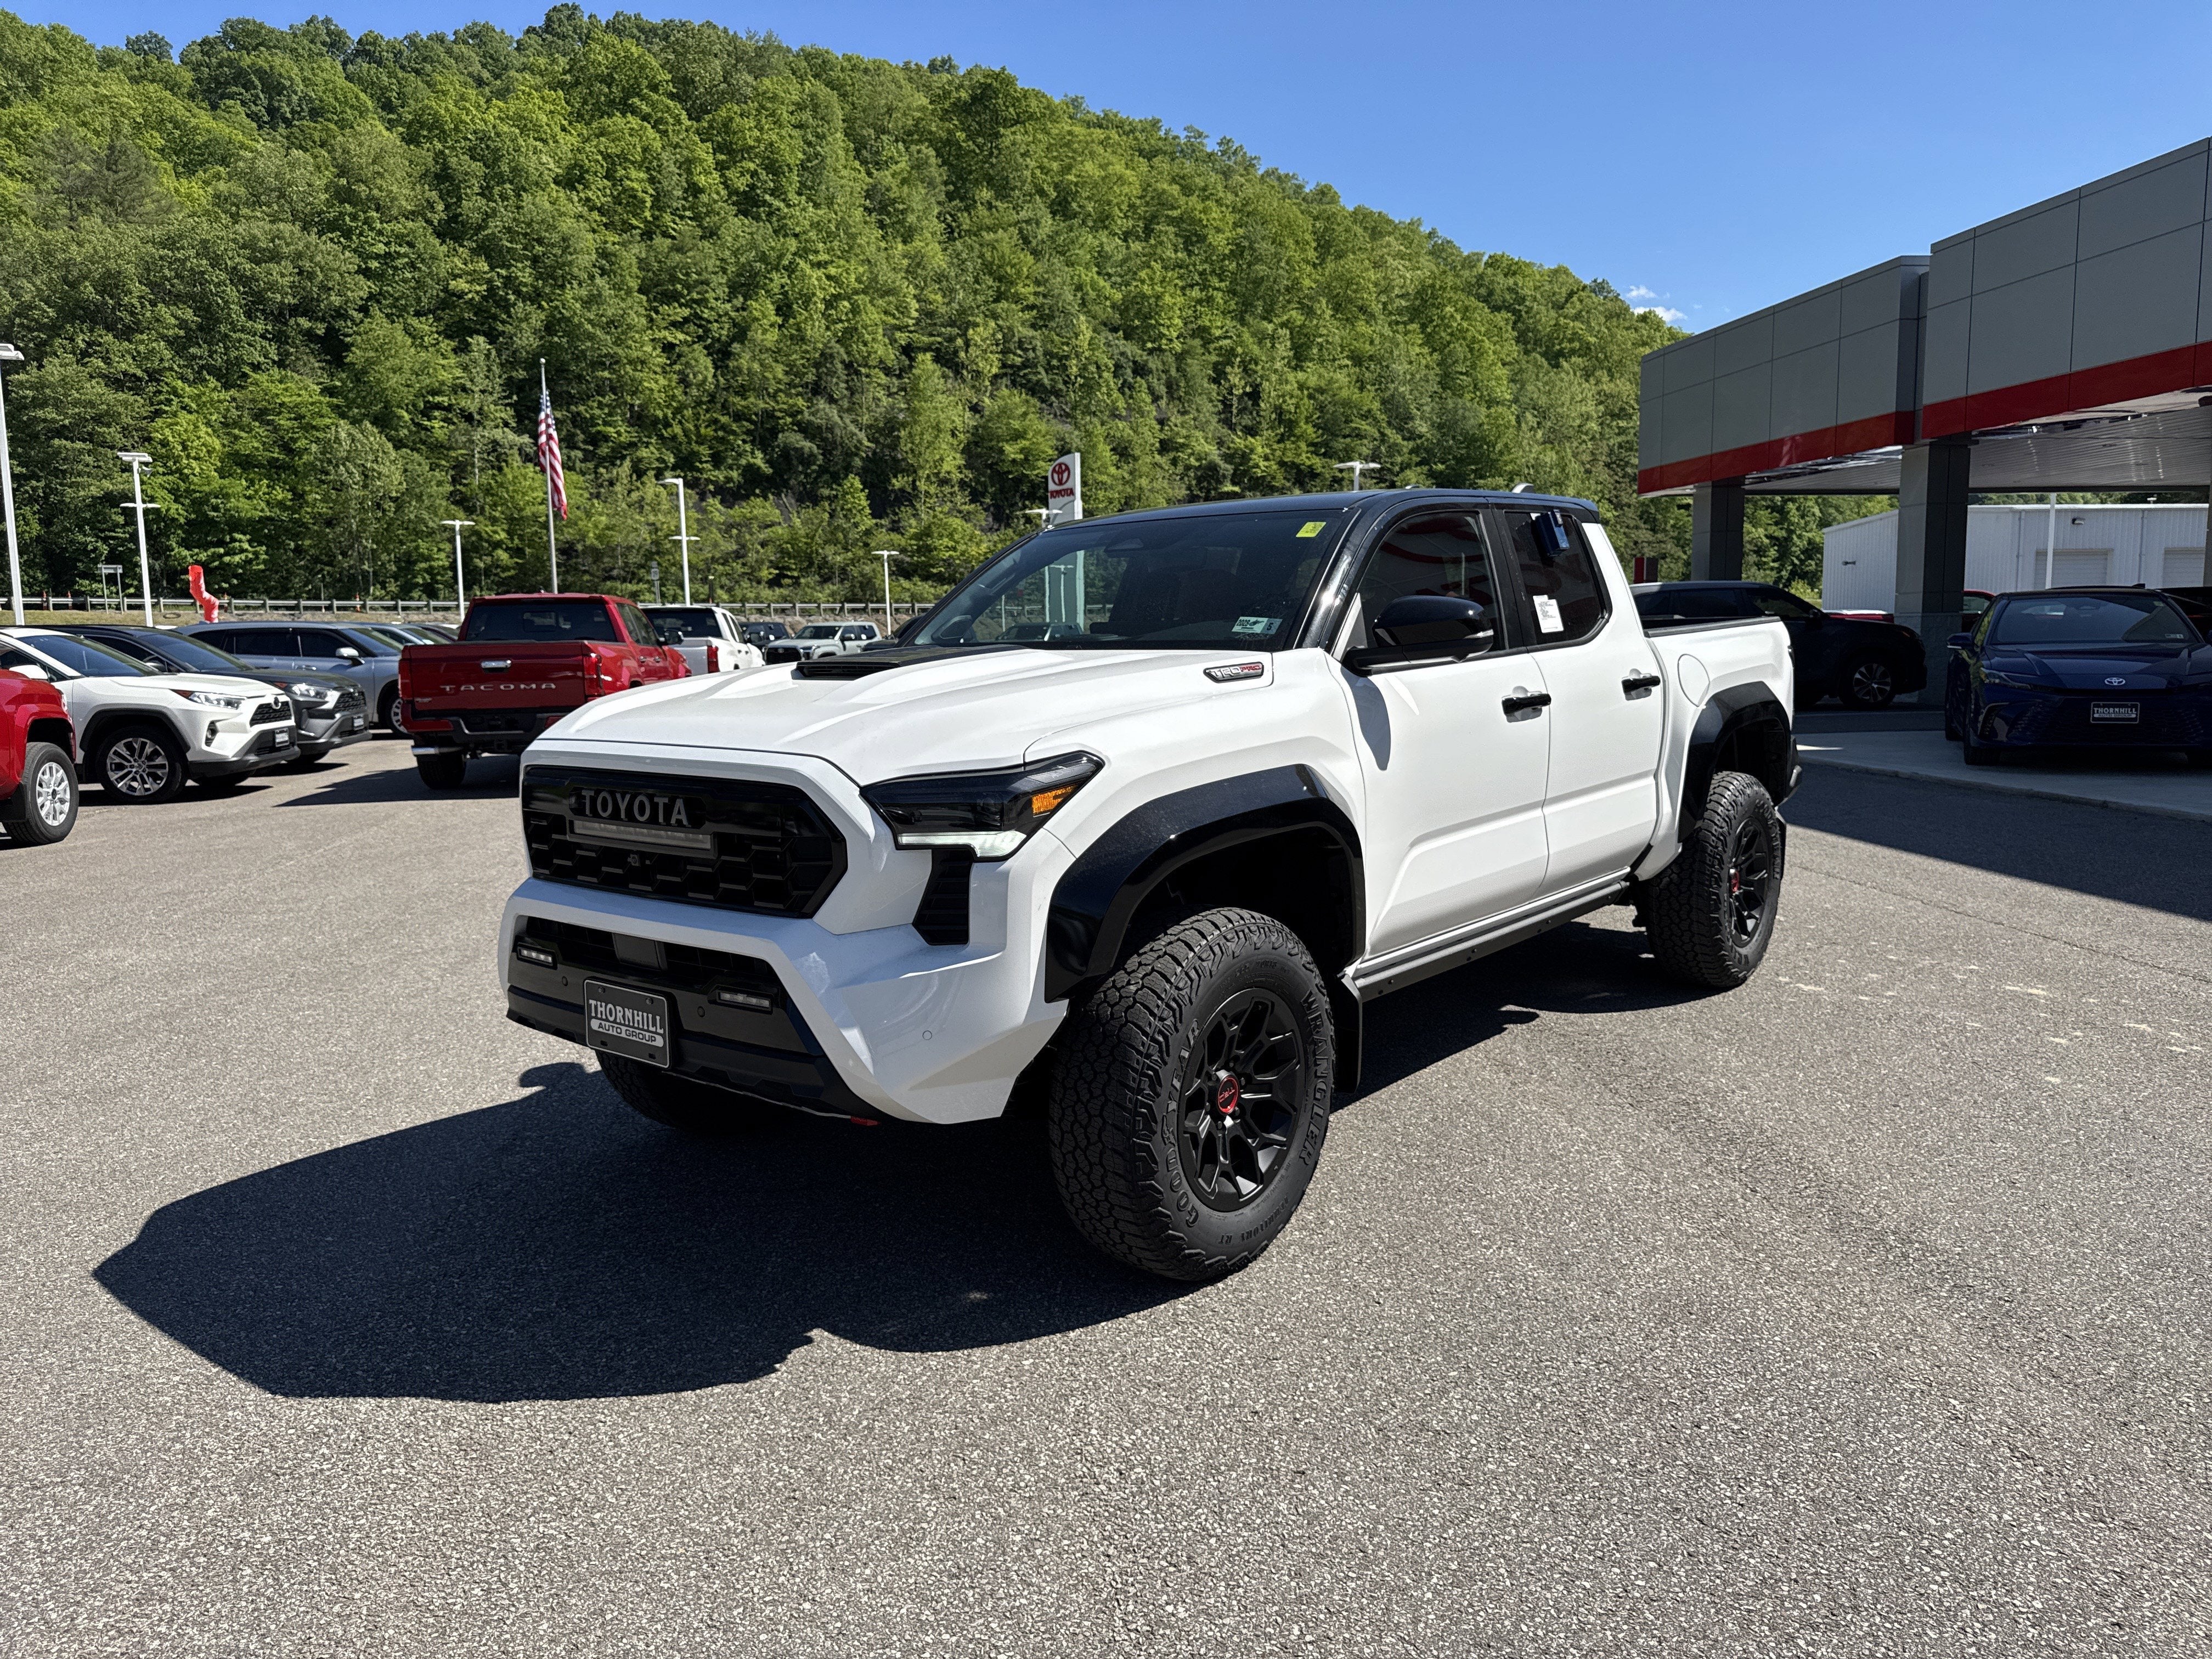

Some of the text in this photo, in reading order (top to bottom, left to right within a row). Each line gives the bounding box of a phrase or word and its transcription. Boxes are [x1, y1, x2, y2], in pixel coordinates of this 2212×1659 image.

[1048, 488, 1074, 499] TOYOTA
[1266, 622, 1273, 630] 5
[440, 683, 556, 693] TACOMA
[582, 789, 690, 827] TOYOTA
[589, 999, 664, 1034] THORNHILL
[598, 1022, 656, 1043] AUTO GROUP
[1299, 990, 1329, 1166] WRANGLER
[1161, 1019, 1199, 1227] GOODYEAR
